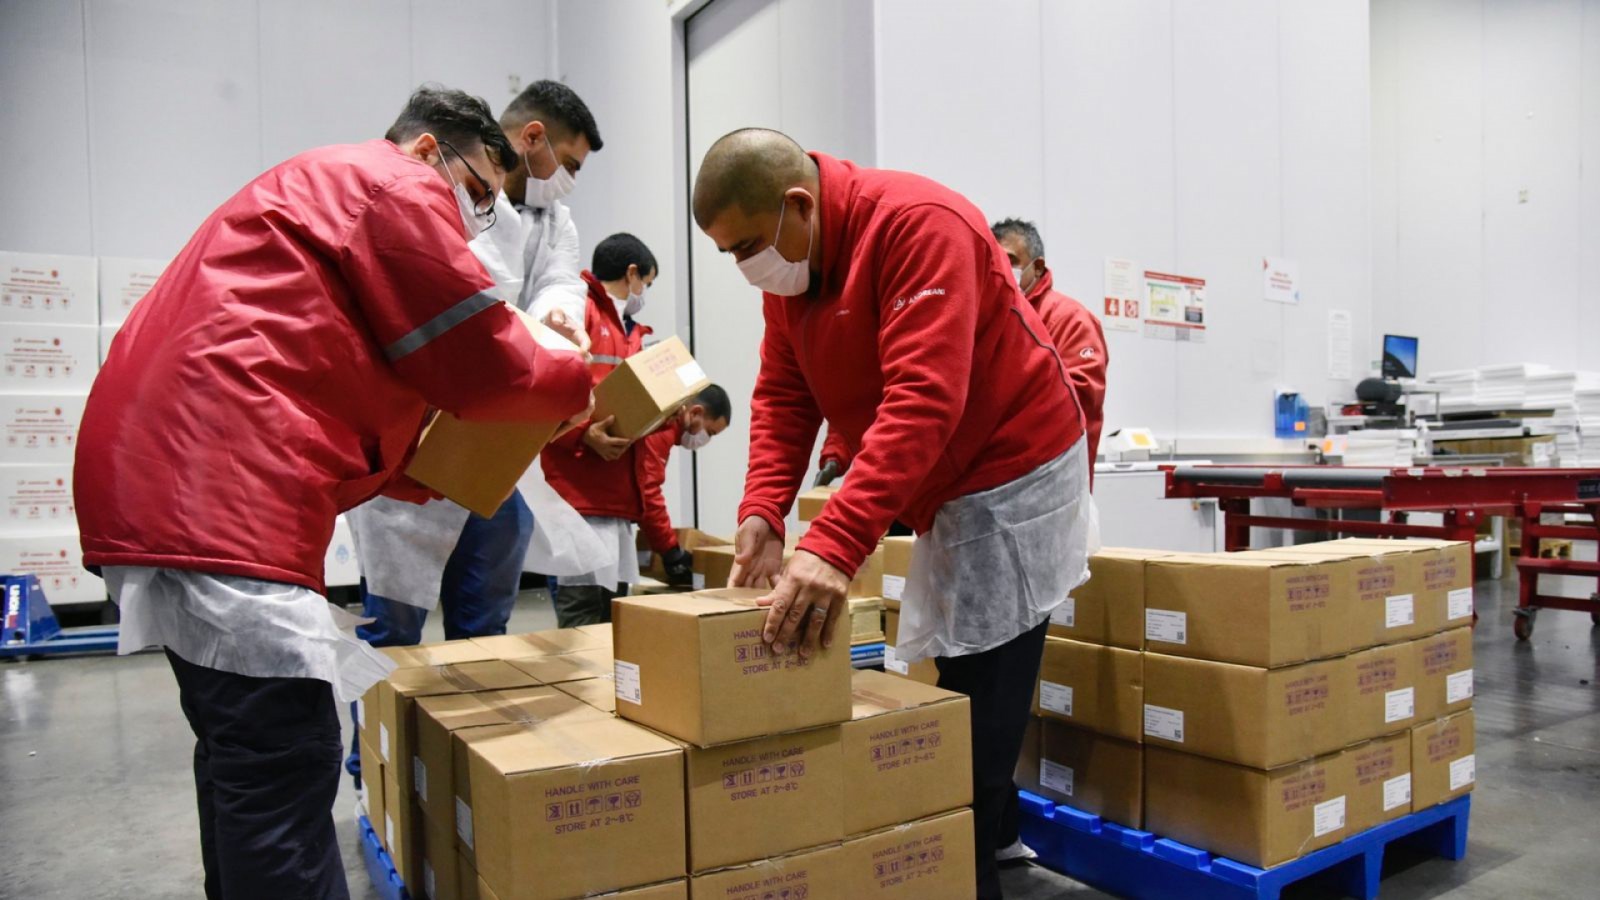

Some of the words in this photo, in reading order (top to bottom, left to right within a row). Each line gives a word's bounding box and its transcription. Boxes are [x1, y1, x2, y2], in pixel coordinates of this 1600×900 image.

[734, 629, 764, 640] HANDL
[743, 664, 769, 675] STORE
[772, 661, 781, 669] AT
[869, 729, 898, 742] HANDLE
[901, 725, 919, 735] WITH
[920, 720, 939, 730] CARE
[723, 756, 757, 767] HANDLE
[759, 751, 780, 761] WITH
[782, 747, 804, 757] CARE
[877, 760, 900, 772] STORE
[545, 784, 585, 797] HANDLE
[588, 780, 612, 791] WITH
[615, 775, 640, 787] CARE
[731, 789, 757, 801] STORE
[761, 786, 770, 795] AT
[555, 821, 586, 834] STORE
[590, 819, 601, 828] AT
[872, 846, 901, 859] HANDLE
[924, 834, 942, 845] CARE
[727, 881, 760, 894] HANDLE
[763, 876, 783, 887] WITH
[785, 870, 807, 882] CARE
